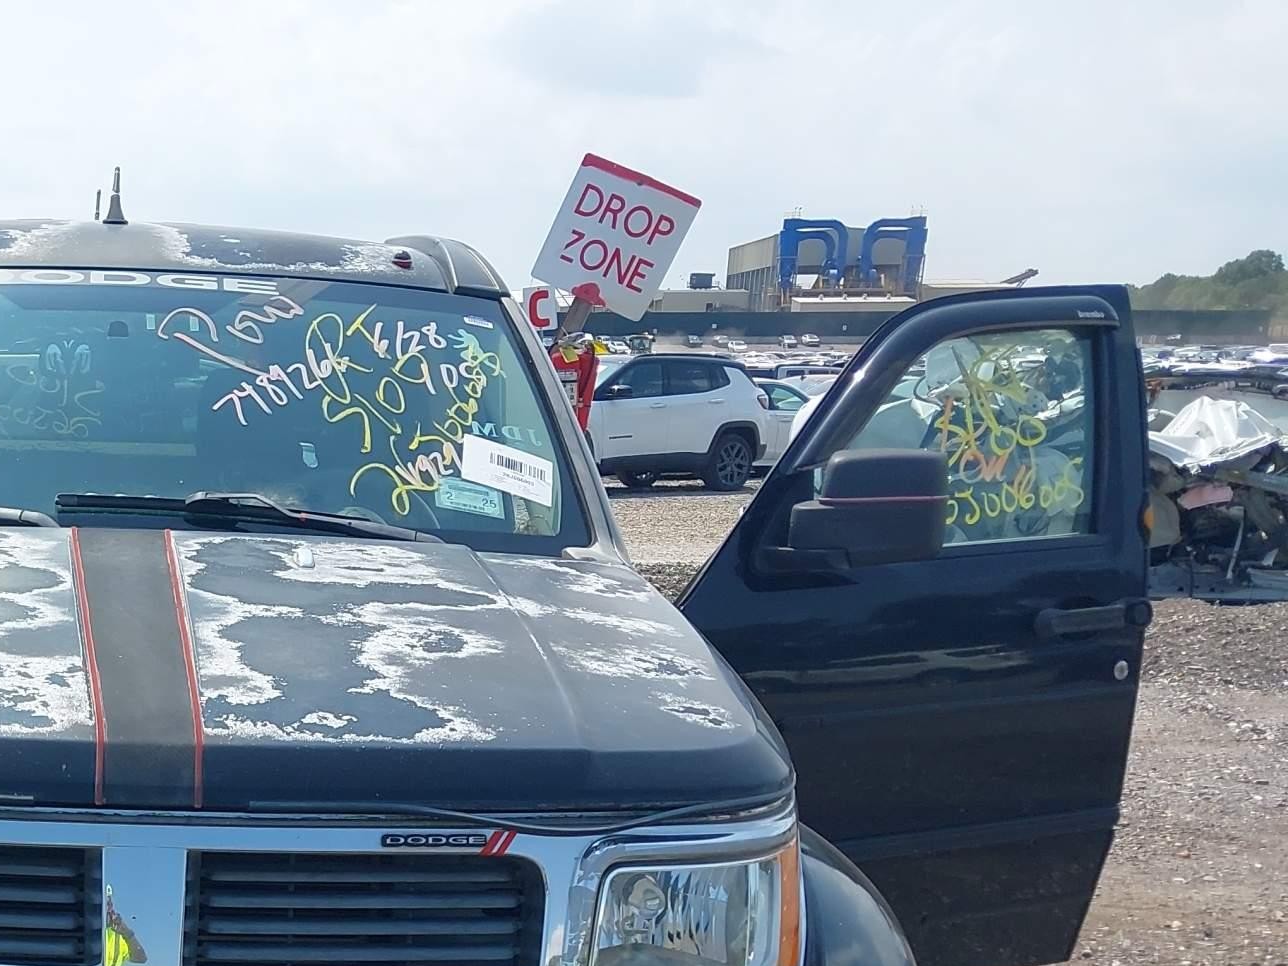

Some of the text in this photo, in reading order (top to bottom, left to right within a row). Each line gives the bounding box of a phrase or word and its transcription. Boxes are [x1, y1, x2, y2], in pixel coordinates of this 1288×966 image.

[574, 183, 675, 246] DROP
[559, 229, 655, 294] ZONE
[528, 290, 551, 329] C
[481, 497, 497, 510] 25
[386, 835, 487, 846] DODGE
